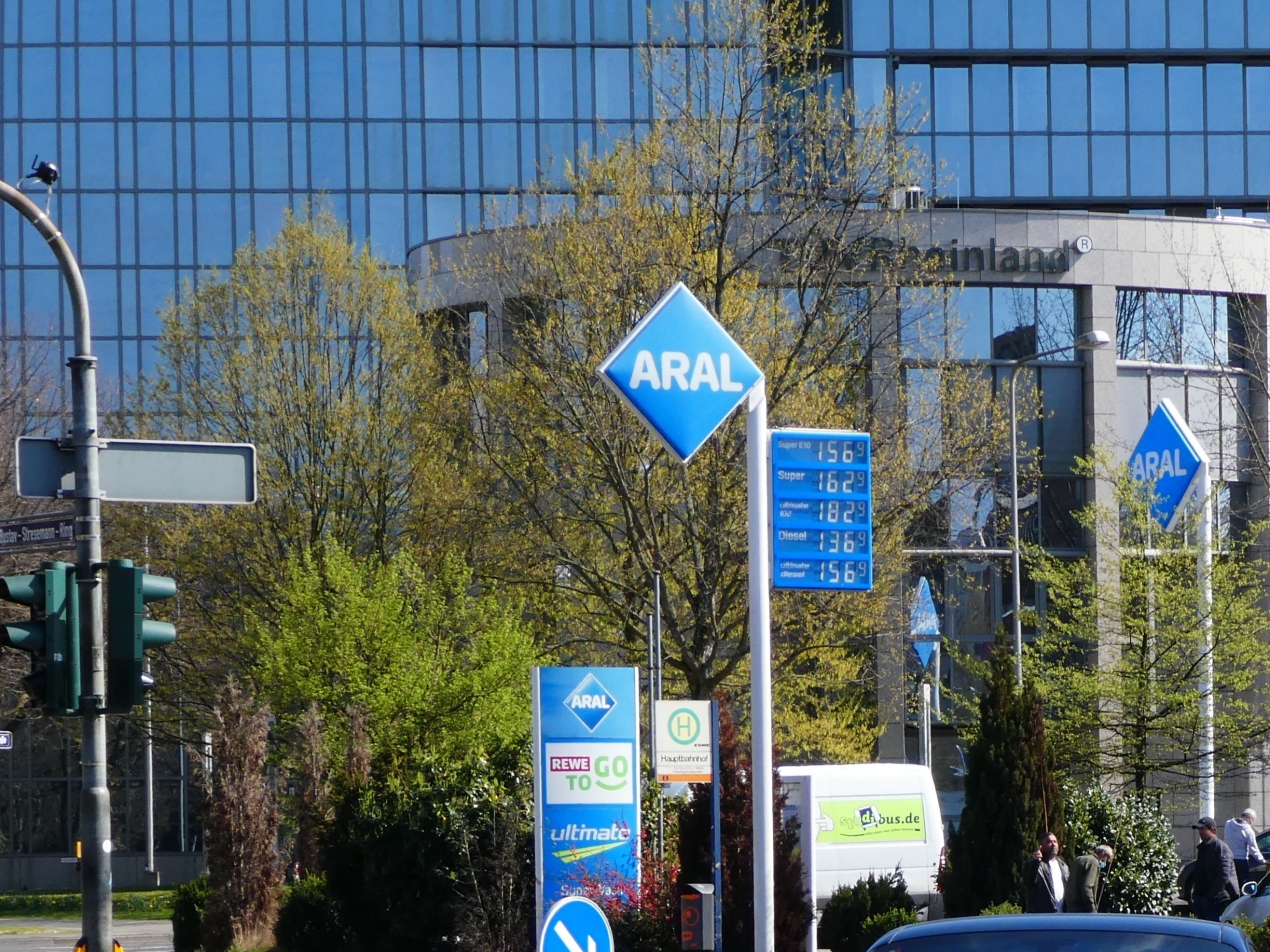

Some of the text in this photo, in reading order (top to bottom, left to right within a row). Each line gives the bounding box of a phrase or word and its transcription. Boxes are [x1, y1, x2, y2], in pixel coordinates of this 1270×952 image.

[629, 350, 744, 392] ARAL
[778, 441, 797, 449] Super
[1132, 448, 1187, 481] ARAL
[778, 470, 805, 481] Super
[780, 510, 792, 518] 102
[778, 531, 807, 541] Diesel
[571, 694, 611, 709] ARAL
[677, 716, 691, 737] H
[552, 758, 589, 770] REWE
[661, 754, 708, 763] Hauptbahnhof
[566, 755, 628, 791] TO GO
[550, 823, 630, 841] ultimate
